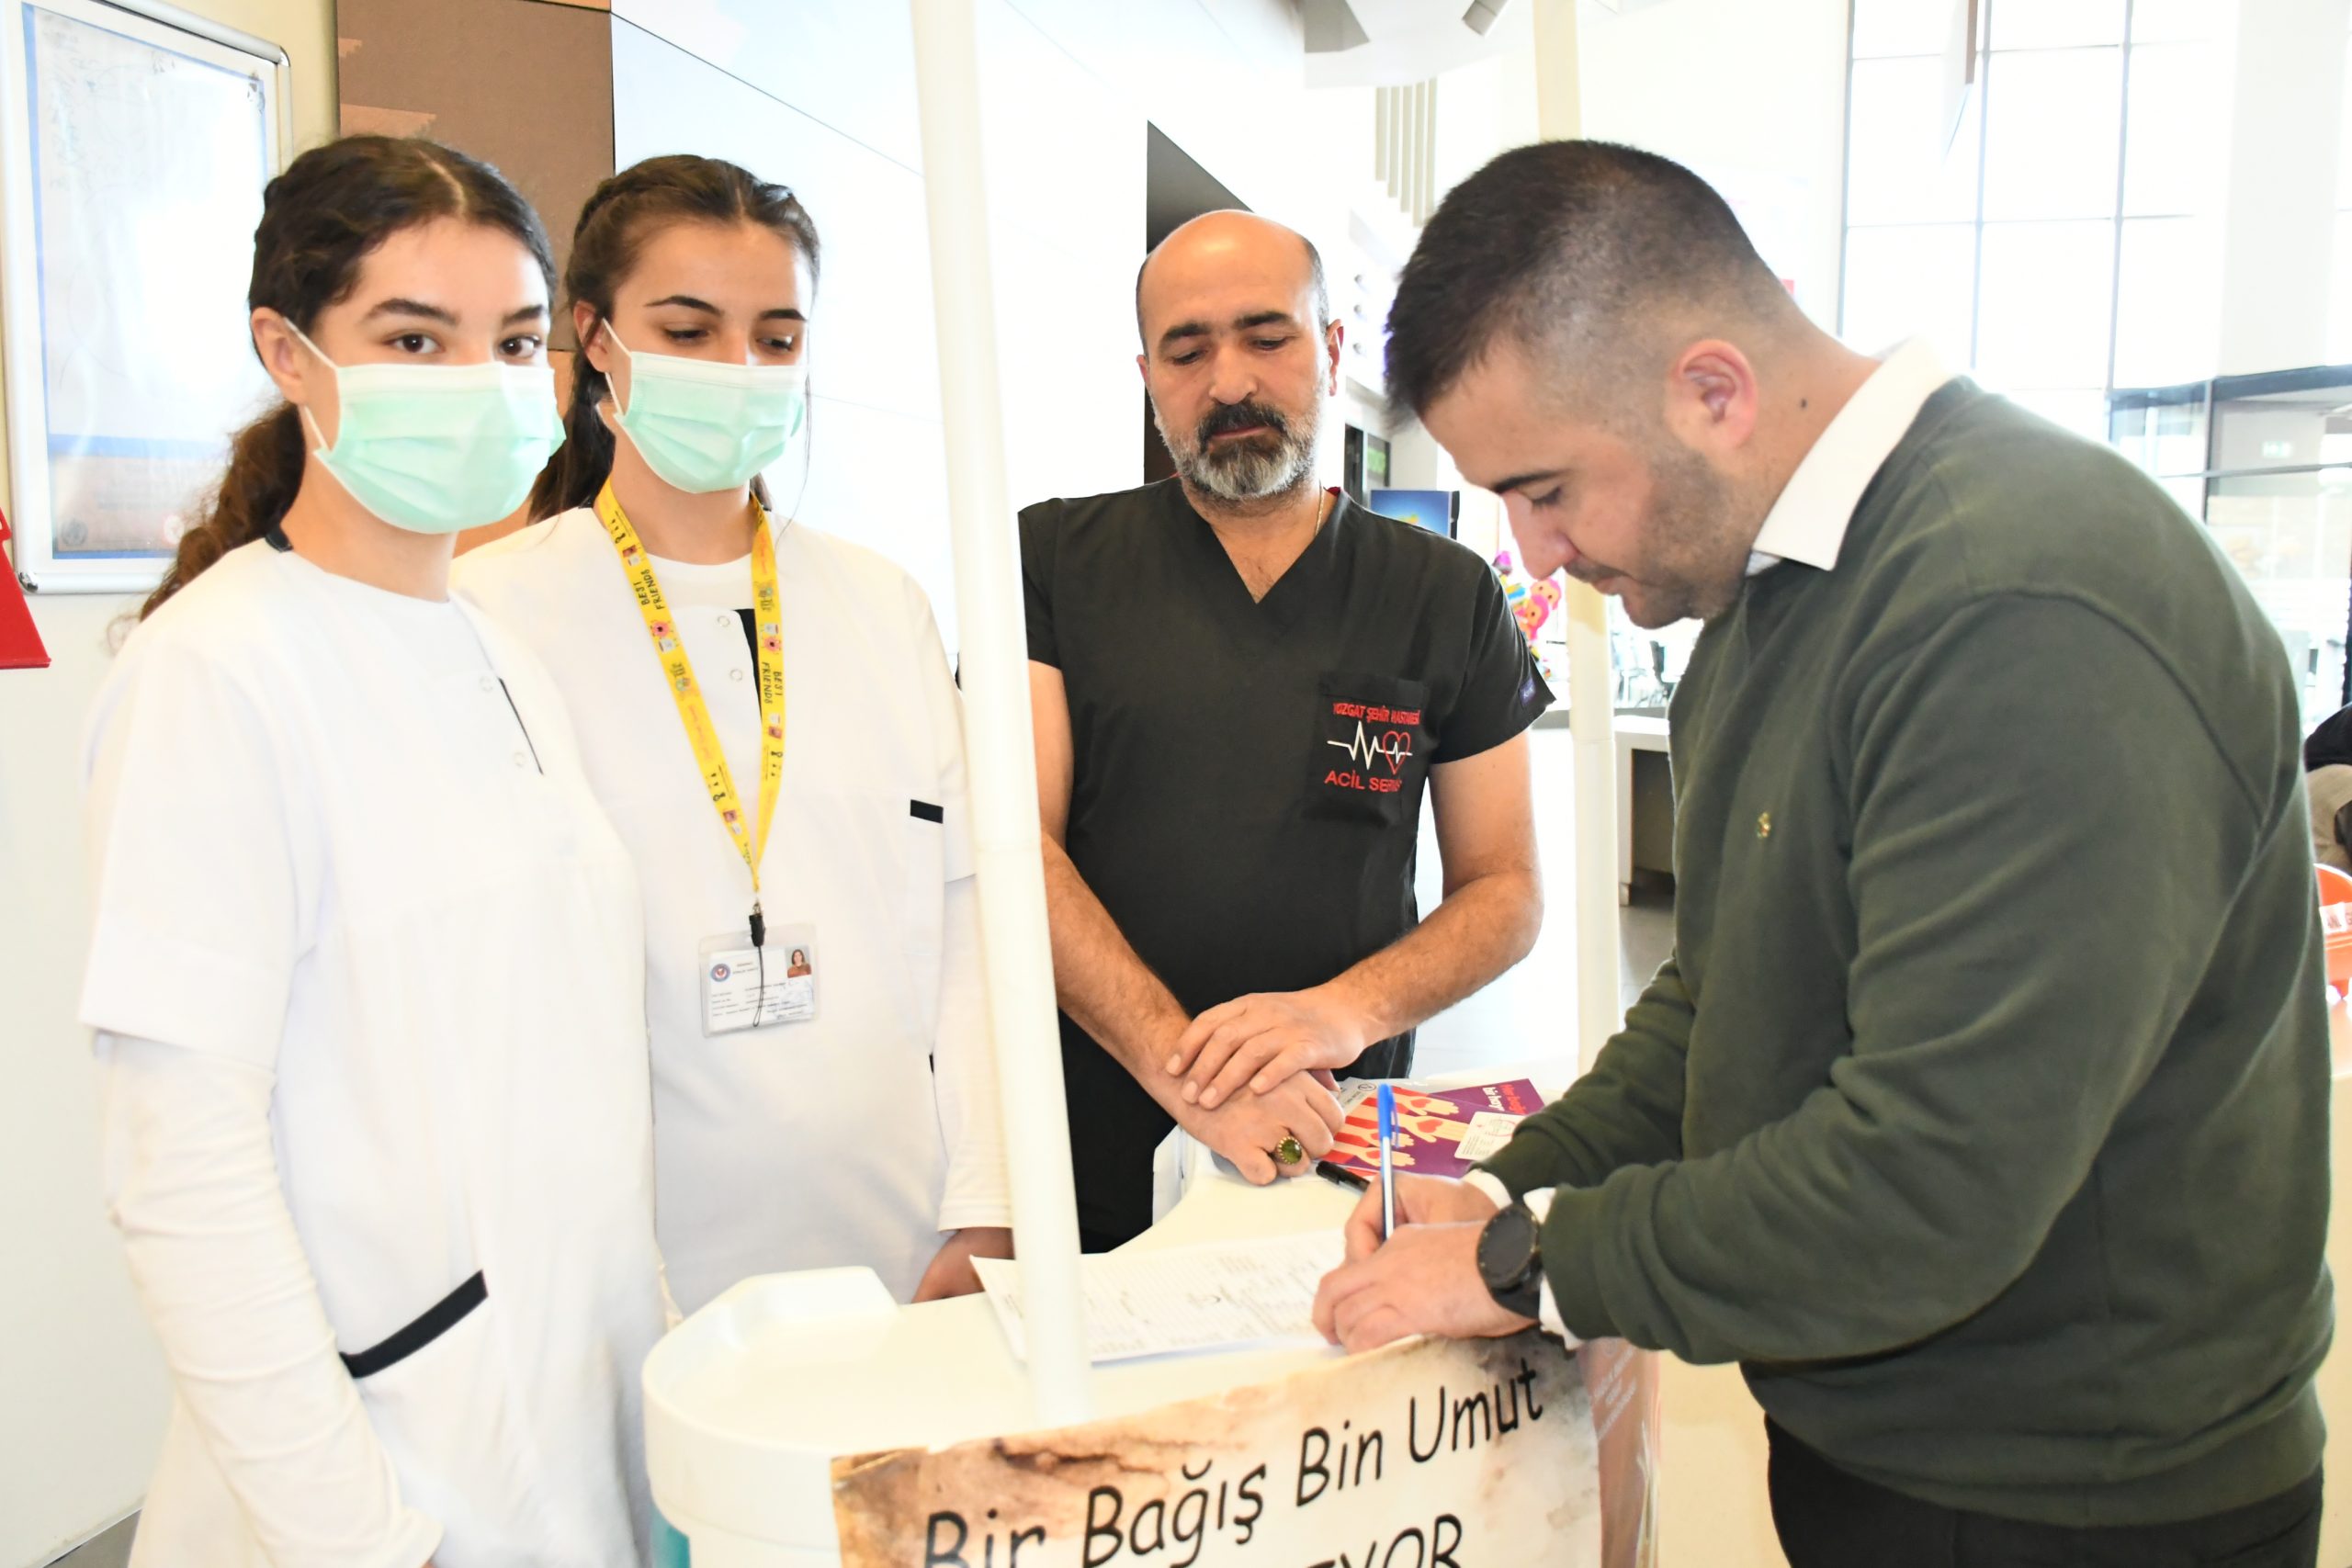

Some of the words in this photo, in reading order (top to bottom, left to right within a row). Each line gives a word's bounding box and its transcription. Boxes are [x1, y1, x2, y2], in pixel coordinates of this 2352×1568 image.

[640, 569, 665, 610] FRIENDS
[1324, 769, 1365, 790] ACİL
[923, 1508, 1046, 1568] Bir
[1081, 1459, 1267, 1568] Bağış
[1296, 1418, 1384, 1507] Bin
[1409, 1357, 1544, 1462] Umut
